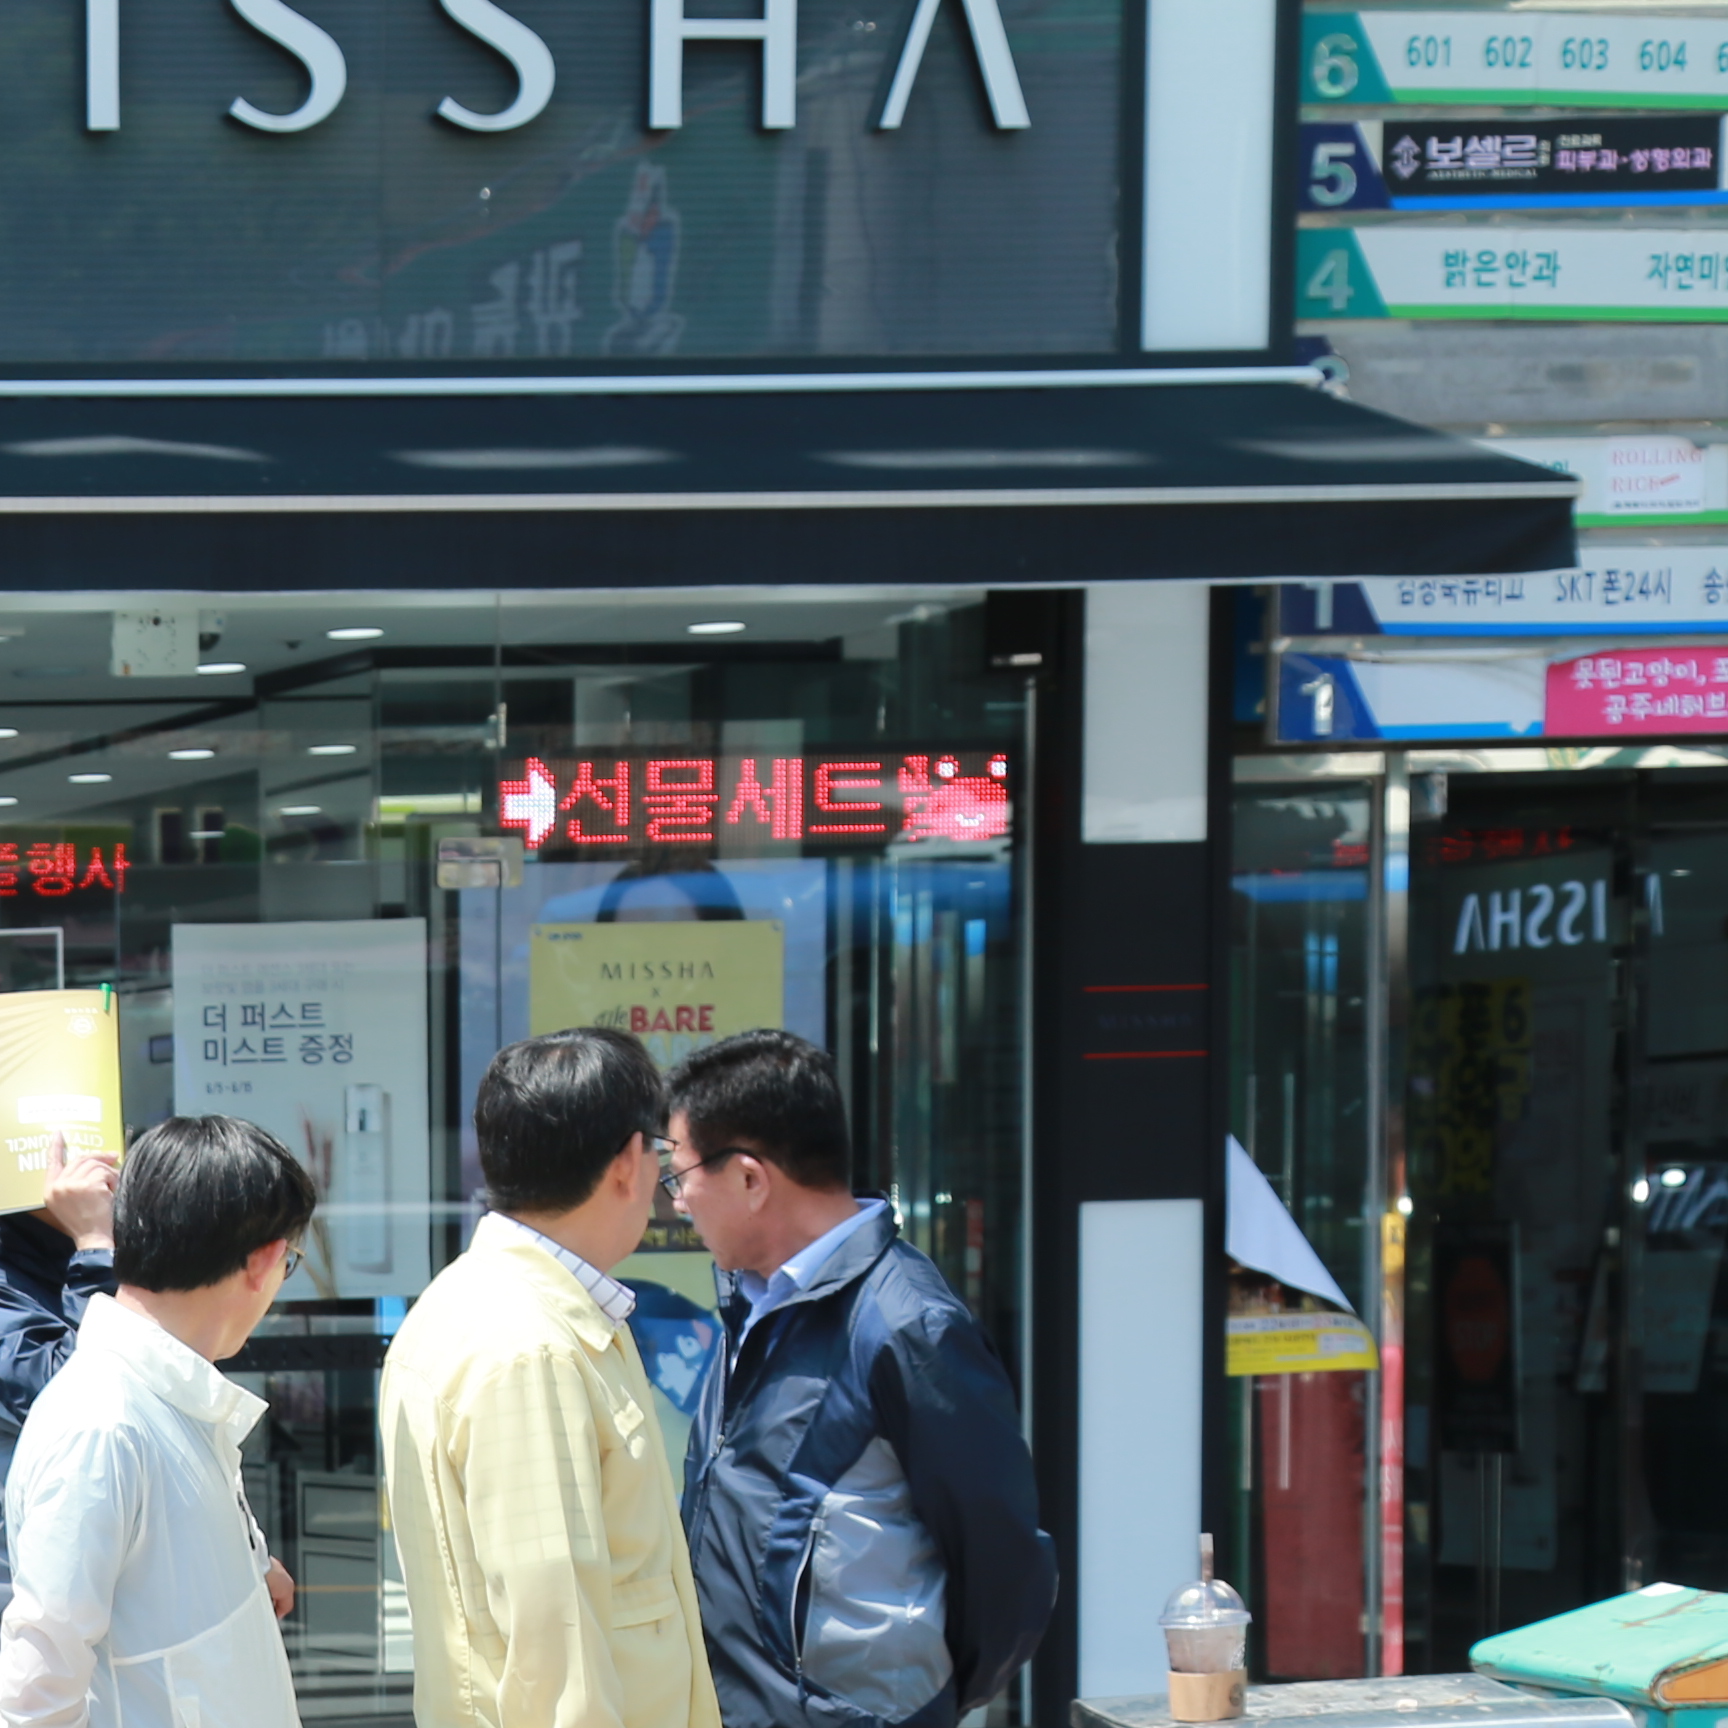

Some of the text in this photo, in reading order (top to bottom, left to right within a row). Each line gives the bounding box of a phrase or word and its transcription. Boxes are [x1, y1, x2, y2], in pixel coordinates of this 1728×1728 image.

[1308, 33, 1358, 98] 6
[1407, 35, 1452, 68] 601
[1485, 36, 1533, 70] 602
[1561, 38, 1610, 71] 603
[1640, 40, 1687, 73] 604
[1425, 134, 1538, 170] 보셀르
[1308, 141, 1357, 206] 5
[1306, 248, 1354, 310] 4
[1443, 248, 1728, 291] 밝은안과 자연미
[1613, 446, 1703, 466] ROLLING
[1556, 571, 1596, 603] SKT
[1604, 567, 1673, 605] 폰24시
[560, 757, 887, 844] 선물세트
[600, 961, 715, 981] MISSHA
[202, 1001, 326, 1033] 더 퍼스트
[630, 1004, 715, 1032] BARE
[203, 1032, 355, 1067] 미스트 증정
